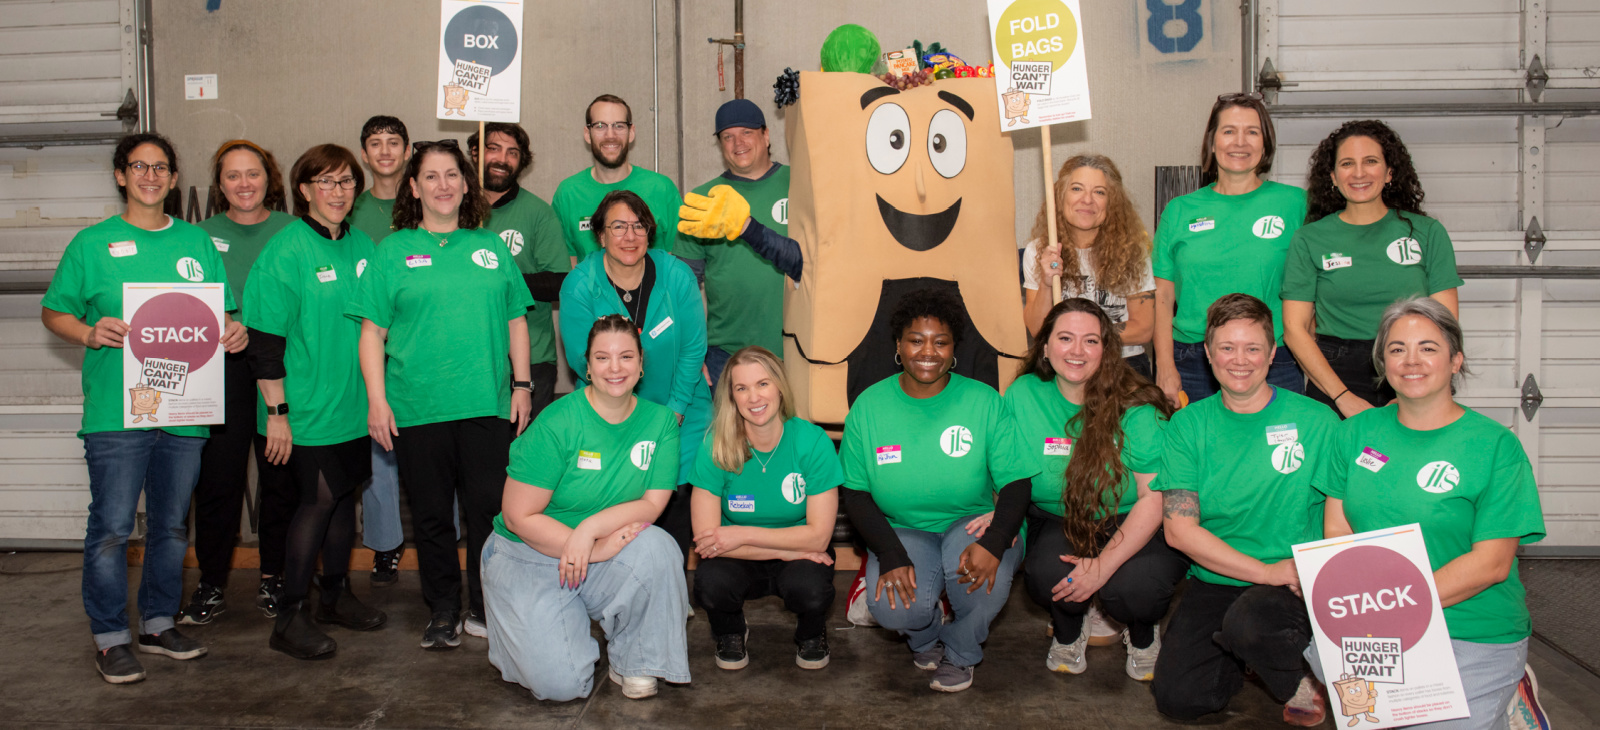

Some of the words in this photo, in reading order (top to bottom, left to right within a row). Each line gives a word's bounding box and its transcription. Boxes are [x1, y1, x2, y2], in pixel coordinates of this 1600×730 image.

[1009, 12, 1060, 36] FOLD
[1146, 0, 1203, 54] 8
[463, 33, 499, 50] BOX
[1011, 35, 1064, 59] BAGS
[456, 61, 490, 76] HUNGER
[1012, 63, 1050, 73] HUNGER
[455, 69, 489, 83] CAN'T
[1012, 72, 1050, 82] CAN'T
[458, 77, 484, 90] WAIT
[1016, 81, 1046, 90] WAIT
[140, 326, 209, 344] STACK
[145, 359, 186, 374] HUNGER
[143, 368, 186, 382] CAN'T
[146, 377, 180, 390] WAIT
[1327, 584, 1418, 619] STACK
[1344, 640, 1399, 653] HUNGER
[1345, 652, 1400, 665] CAN'T
[1351, 664, 1395, 677] WAIT
